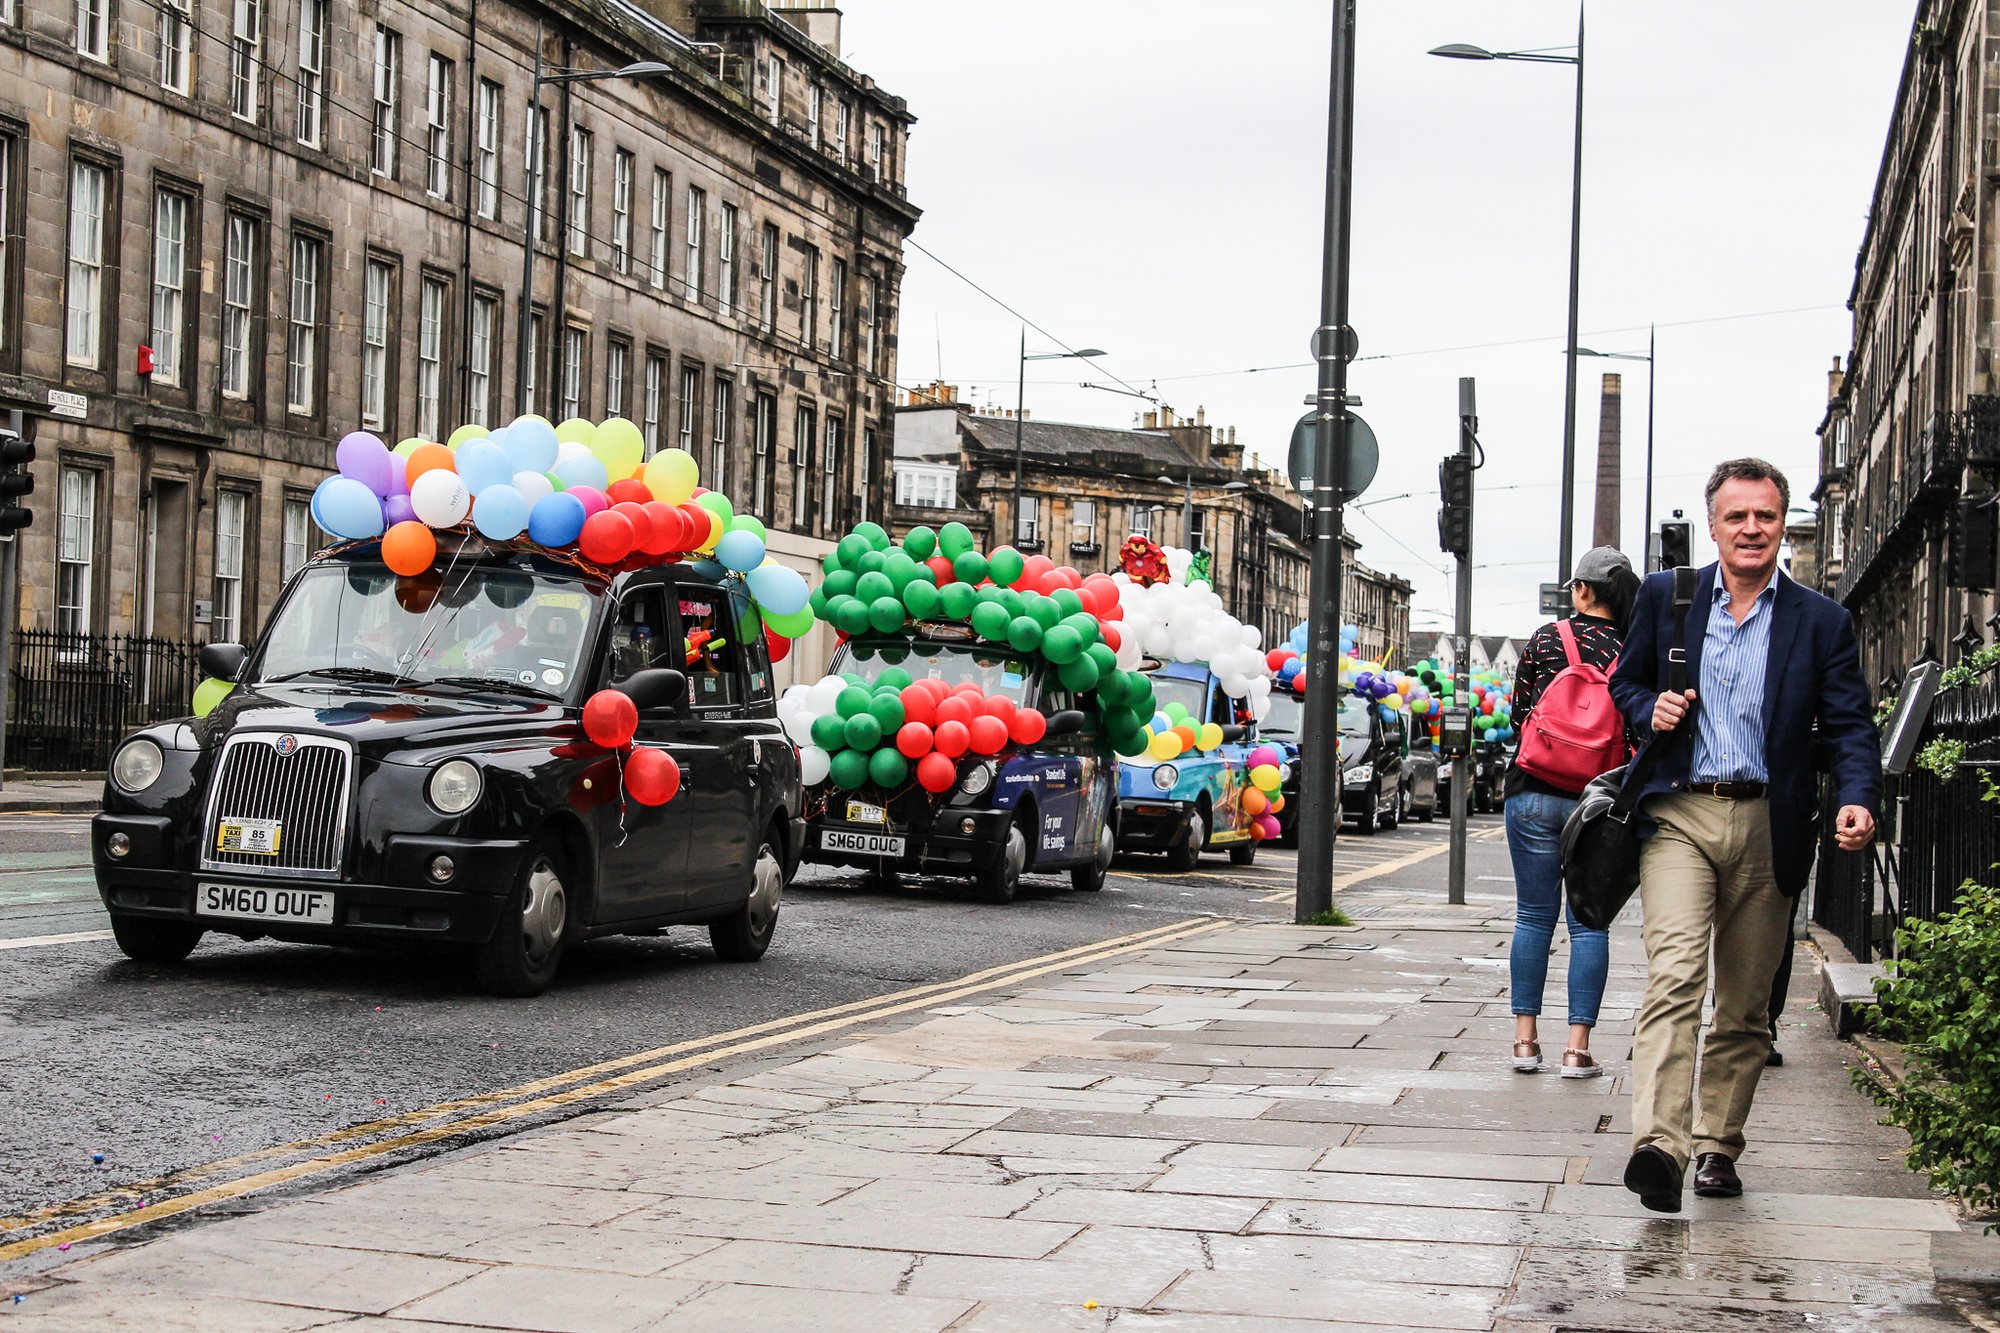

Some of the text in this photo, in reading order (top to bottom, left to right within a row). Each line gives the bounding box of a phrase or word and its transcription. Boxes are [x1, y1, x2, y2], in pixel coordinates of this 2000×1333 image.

[71, 395, 85, 407] PLACE
[1051, 817, 1062, 832] your
[252, 829, 265, 839] 85
[1050, 833, 1065, 851] savings
[828, 833, 898, 852] SM60 OUC
[207, 886, 323, 917] SM60 OUF
